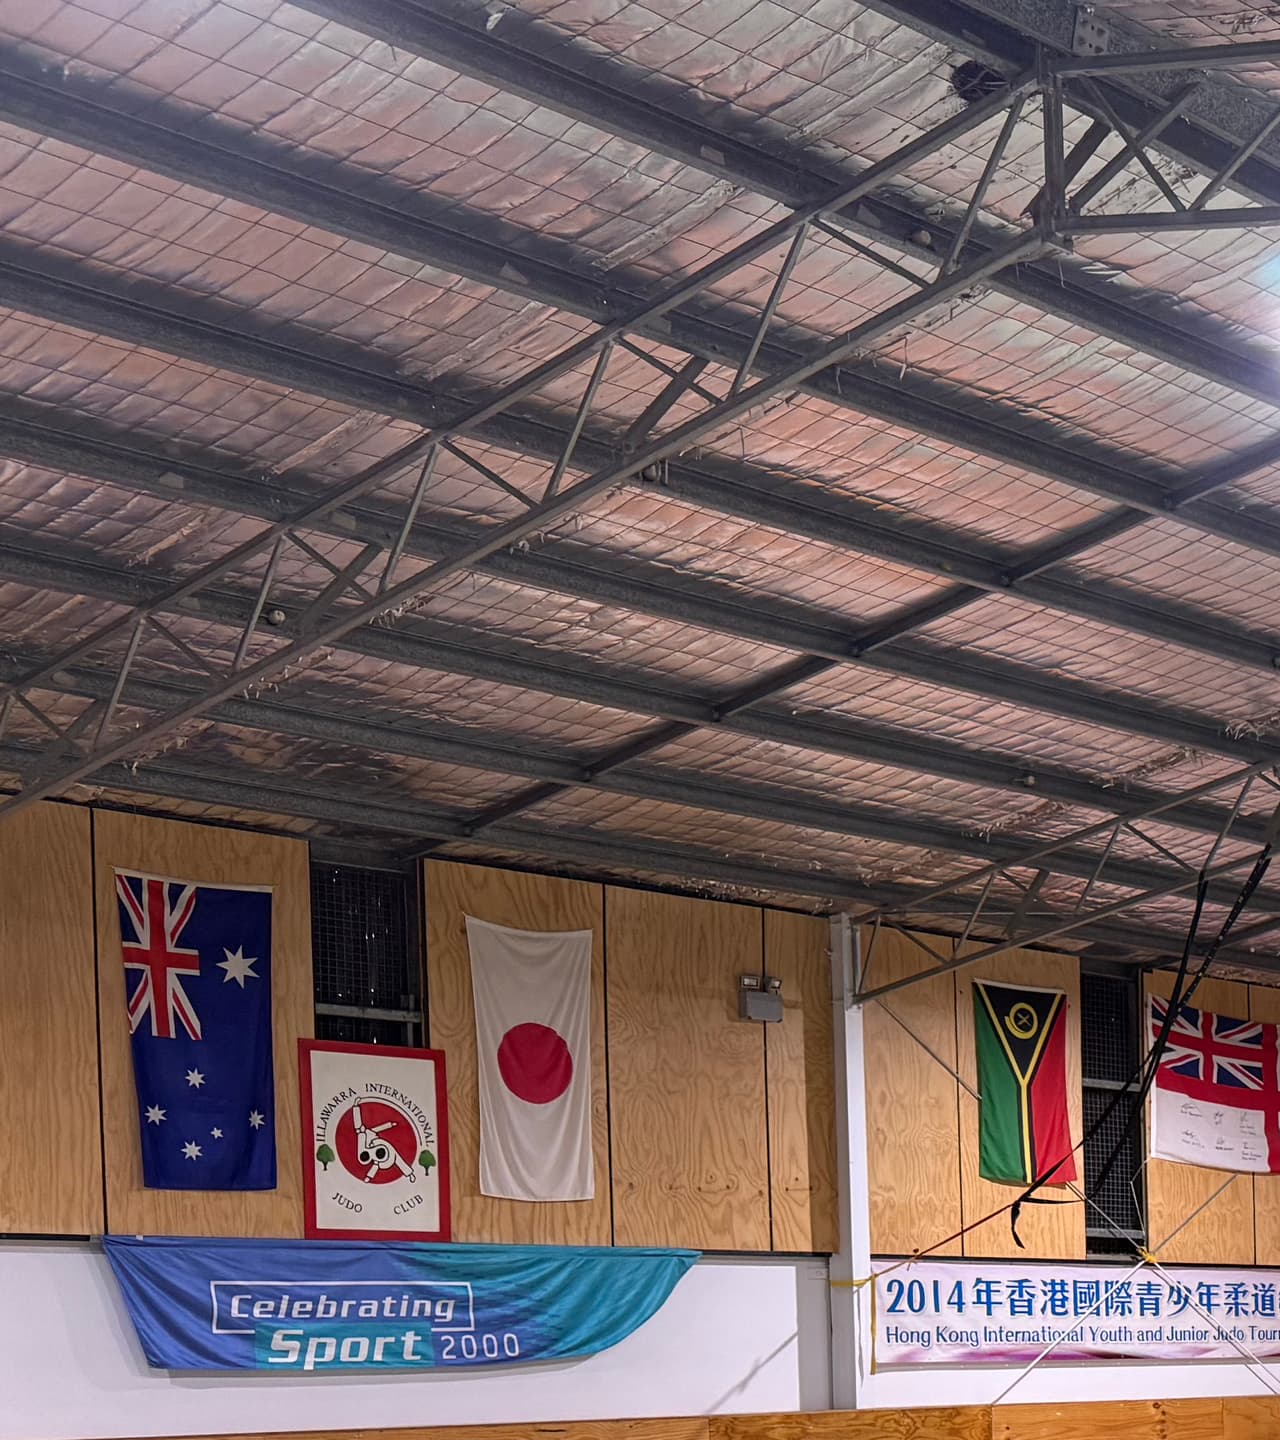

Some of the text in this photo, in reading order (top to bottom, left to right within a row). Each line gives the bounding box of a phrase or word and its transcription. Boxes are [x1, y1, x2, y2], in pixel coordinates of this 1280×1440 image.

[316, 1083, 435, 1147] ILLAWARRA INTERNATIONAL
[332, 1192, 424, 1215] JUDO CLUB
[230, 1295, 456, 1322] Celebrating
[886, 1326, 931, 1346] Hong
[936, 1327, 979, 1346] Kong
[984, 1326, 1084, 1343] International
[1090, 1326, 1132, 1342] Youth
[1137, 1326, 1163, 1342] and
[1166, 1325, 1209, 1342] Junior
[1213, 1325, 1245, 1342] Judo
[268, 1329, 520, 1370] Sport 2000
